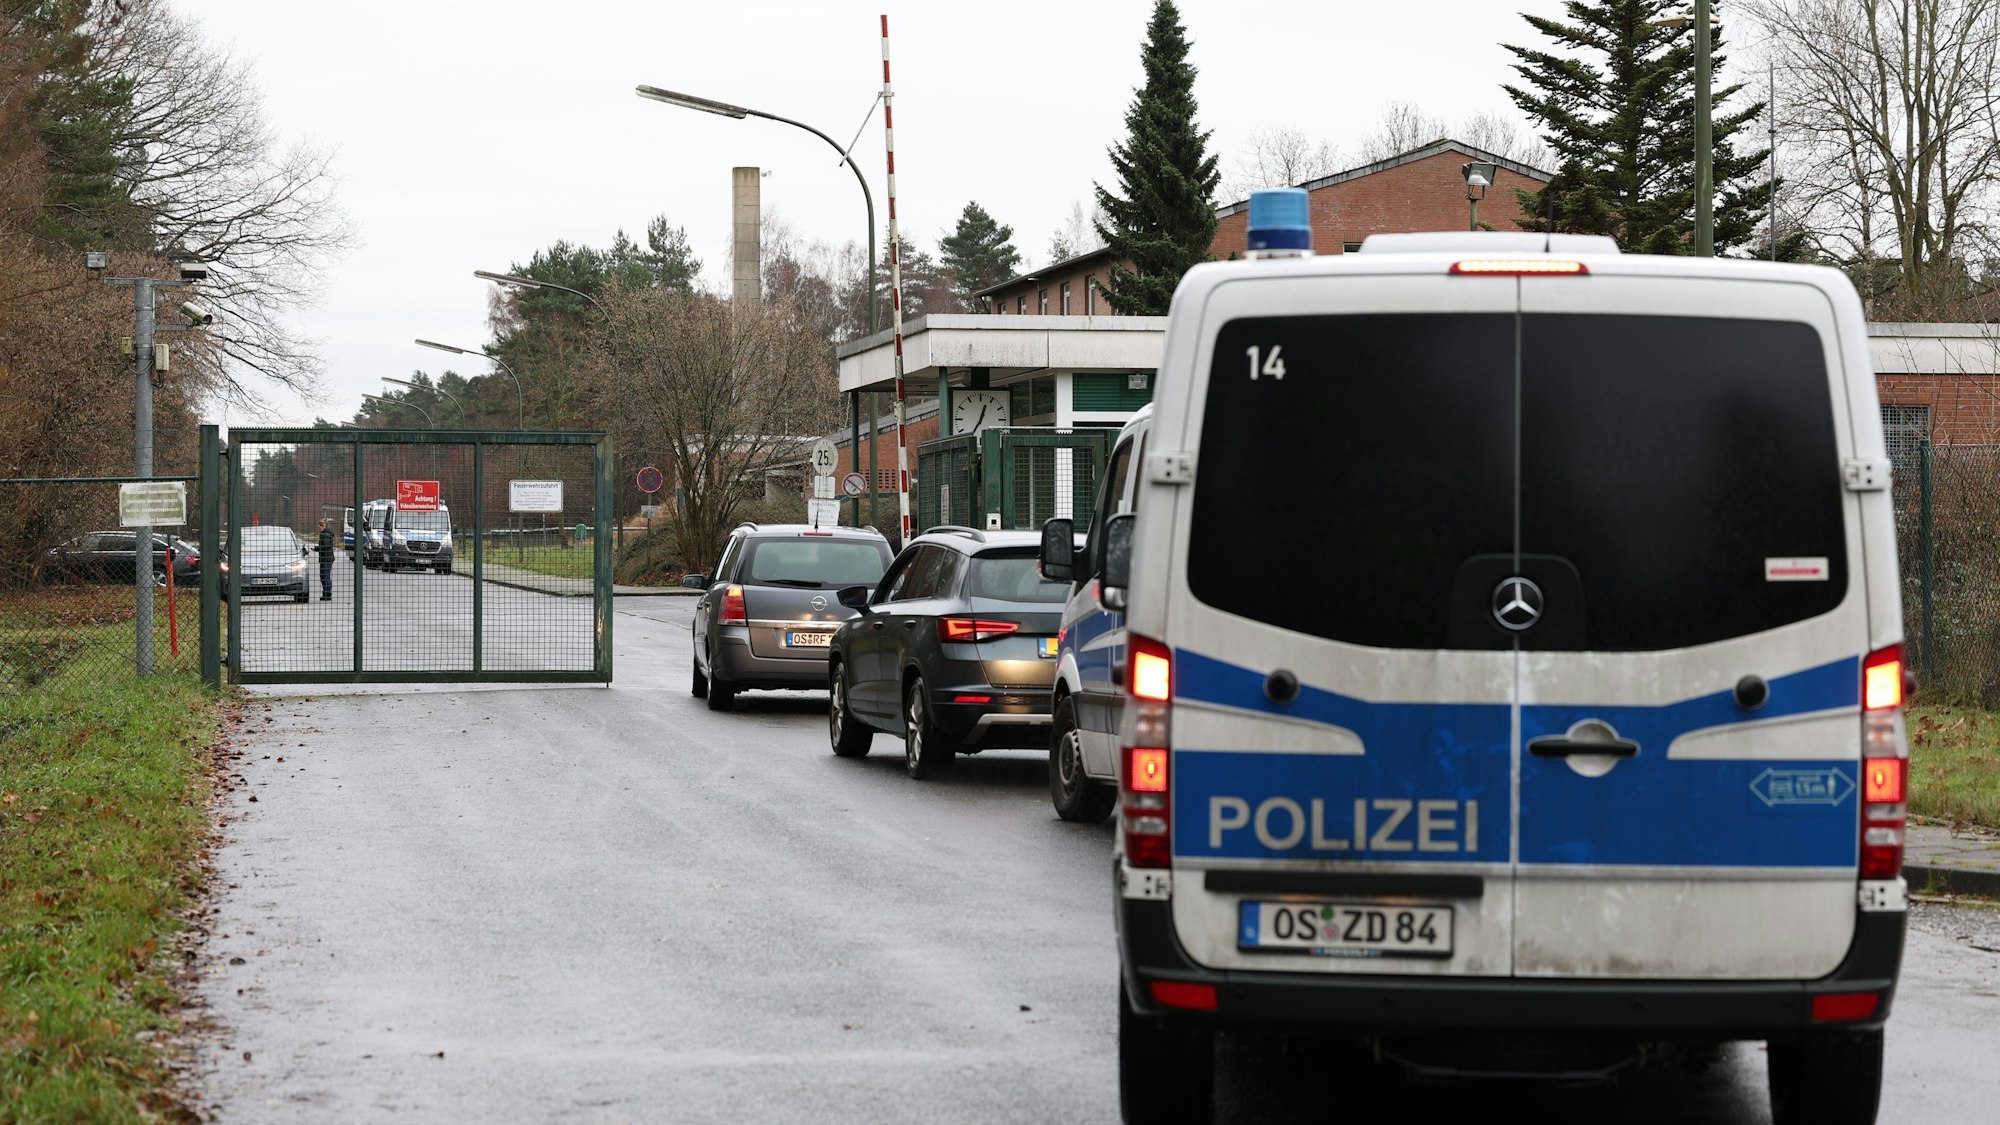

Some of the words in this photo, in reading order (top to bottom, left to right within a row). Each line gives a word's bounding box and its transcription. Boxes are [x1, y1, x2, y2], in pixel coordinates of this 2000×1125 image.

[1246, 344, 1287, 381] 14
[818, 450, 829, 466] 25
[400, 502, 437, 511] Videoüberwachung
[414, 495, 434, 503] Achtung
[794, 633, 807, 645] OS
[813, 634, 826, 645] RF
[1208, 796, 1478, 852] POLIZEI
[1274, 907, 1318, 941] OS
[1341, 910, 1387, 943] ZD
[1395, 911, 1438, 944] 84
